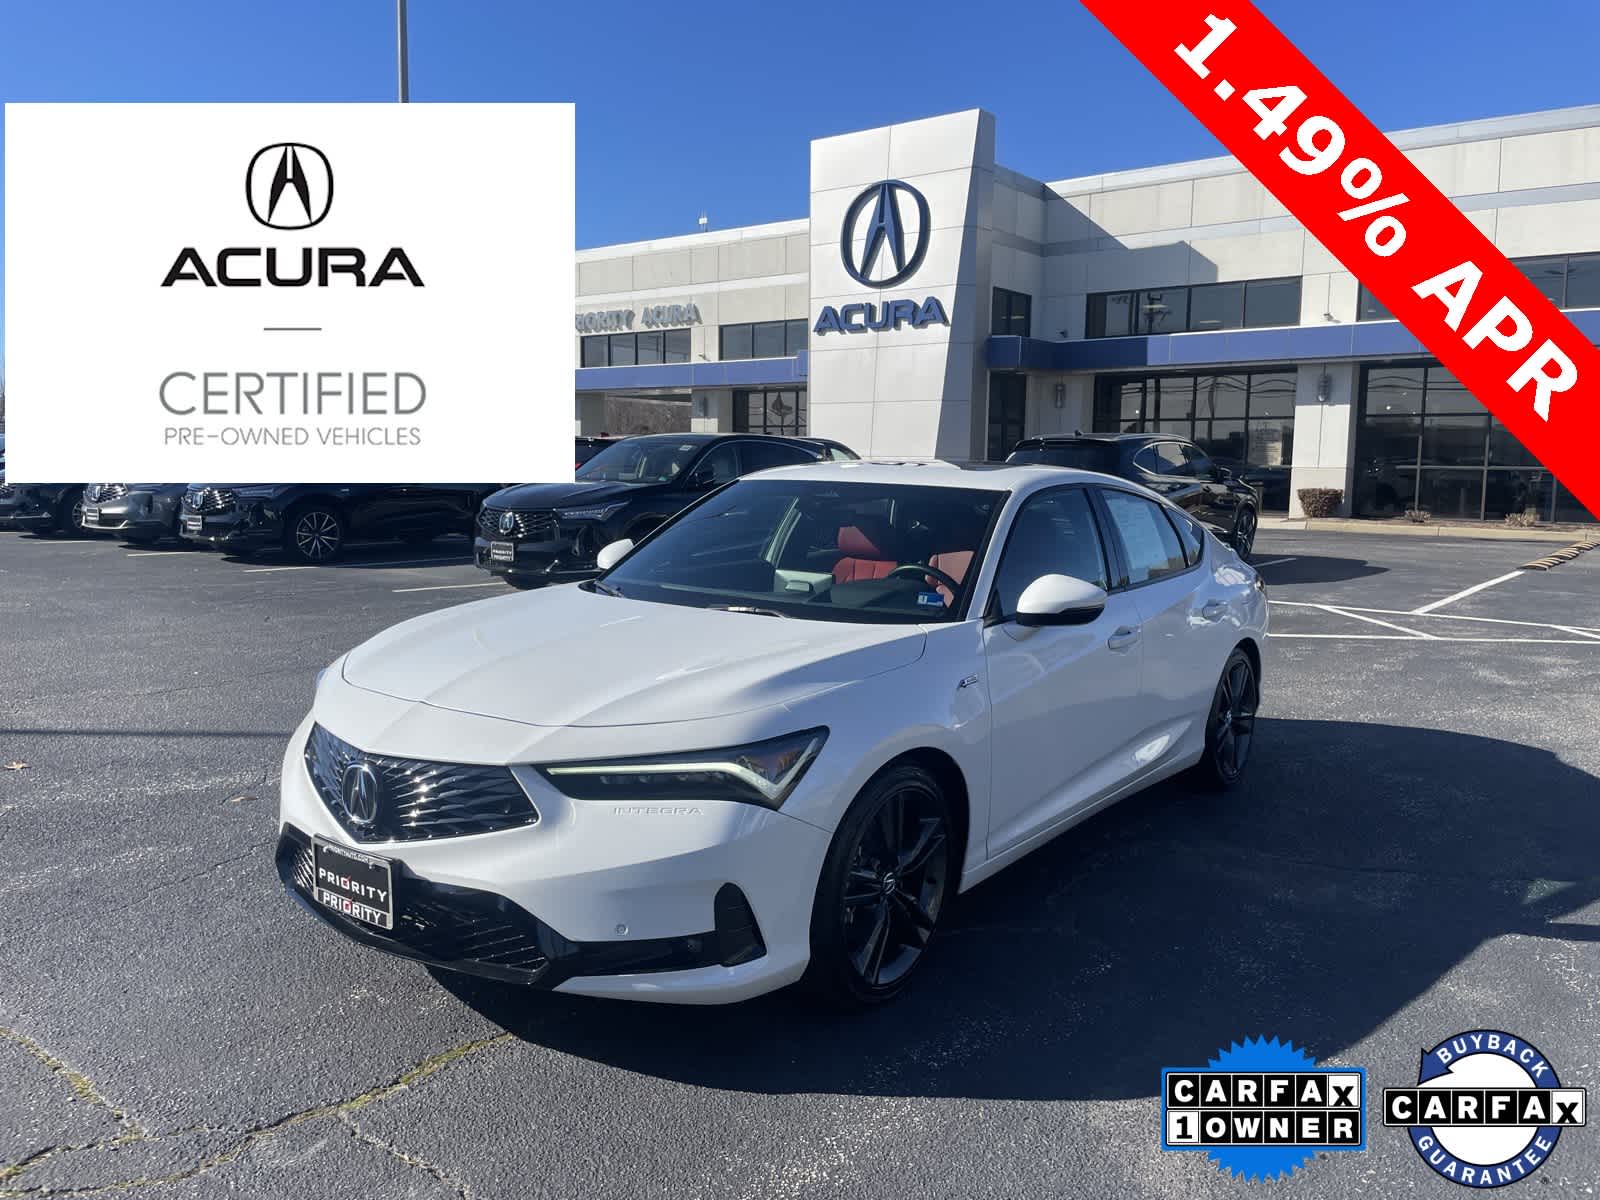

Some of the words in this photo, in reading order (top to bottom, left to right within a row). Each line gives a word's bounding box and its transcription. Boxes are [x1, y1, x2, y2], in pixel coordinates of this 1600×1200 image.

[814, 296, 949, 335] ACURA
[318, 867, 388, 903] PRIORITY
[322, 890, 382, 925] PRIORITY
